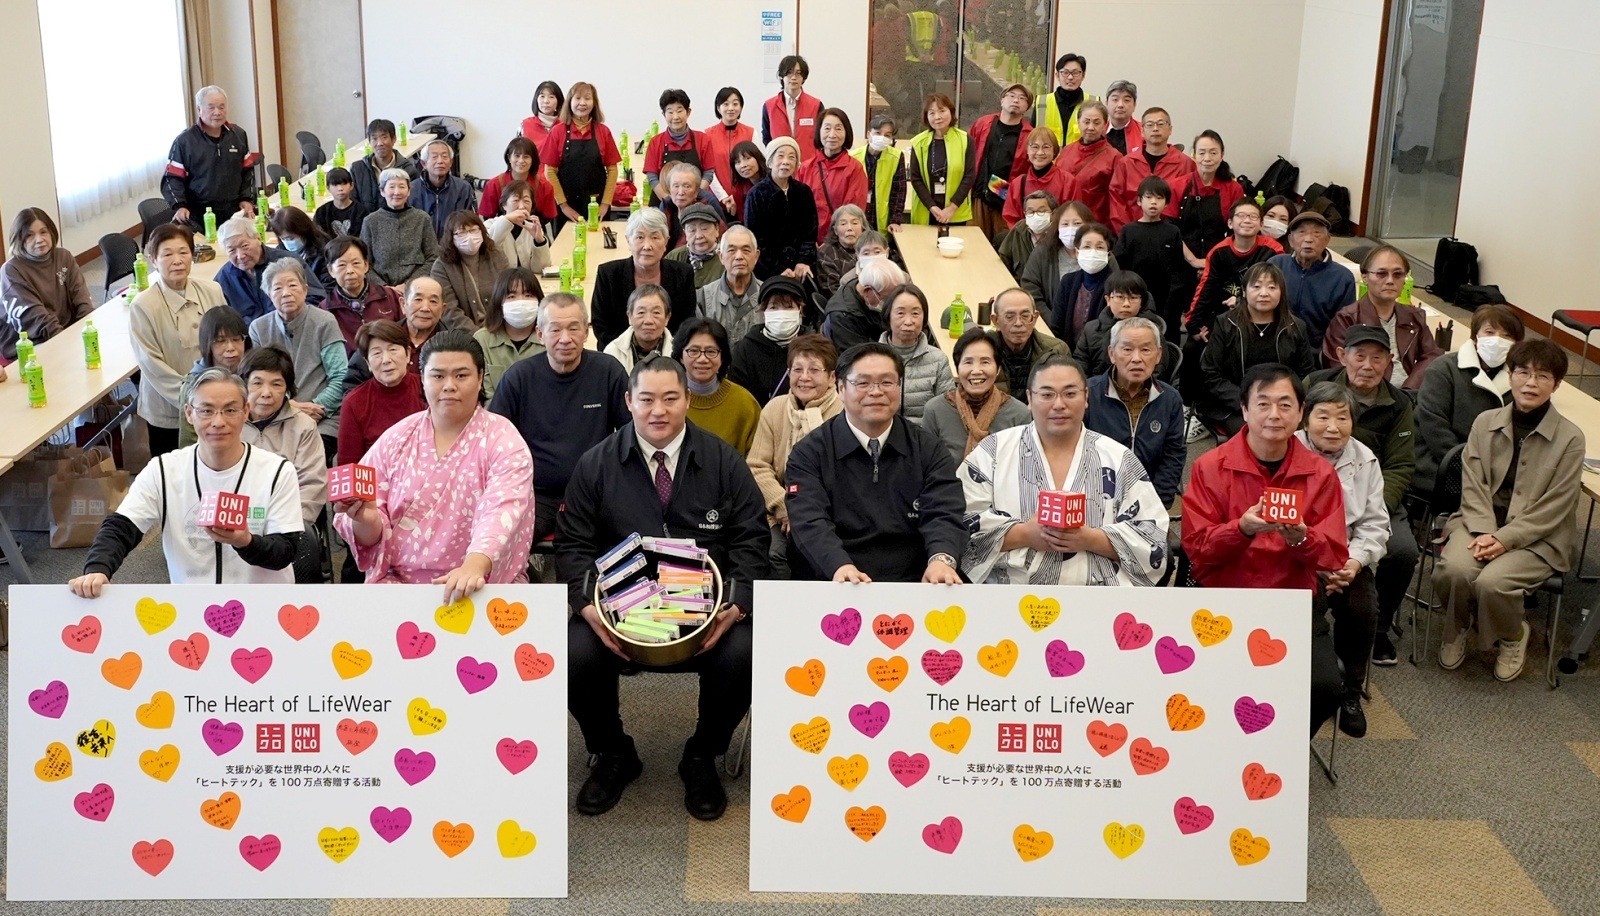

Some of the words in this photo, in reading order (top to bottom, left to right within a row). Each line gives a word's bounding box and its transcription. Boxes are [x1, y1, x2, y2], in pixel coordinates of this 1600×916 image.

[332, 468, 350, 483] ユニ
[355, 468, 373, 482] UNI
[331, 483, 350, 497] クロ
[355, 482, 374, 496] QLO
[221, 496, 244, 512] UNI
[1042, 496, 1062, 510] ユニ
[1066, 499, 1082, 511] UNI
[1271, 492, 1296, 506] UNI
[218, 511, 244, 526] QLO
[1040, 510, 1061, 524] クロ
[1066, 512, 1083, 526] QLO
[1269, 506, 1297, 520] QLO
[879, 620, 902, 628] とにかく
[876, 627, 909, 636] 体調管理
[184, 695, 217, 713] The
[225, 695, 275, 713] Heart
[282, 695, 299, 713] of
[308, 695, 392, 713] LifeWear
[926, 693, 960, 712] The
[967, 694, 1017, 712] Heart
[1024, 695, 1041, 713] of
[1050, 696, 1135, 714] LifeWear
[260, 727, 281, 738] ユニ
[294, 727, 316, 738] UNI
[1001, 726, 1023, 737] ユニ
[1036, 727, 1057, 738] UNI
[259, 739, 282, 750] クロ
[294, 738, 317, 750] QLO
[1001, 738, 1023, 749] クロ
[1036, 739, 1059, 751] QLO
[225, 764, 351, 775] 支援が必要な世界中の人々に
[966, 763, 1092, 775] 支援が必要な世界中の人々に
